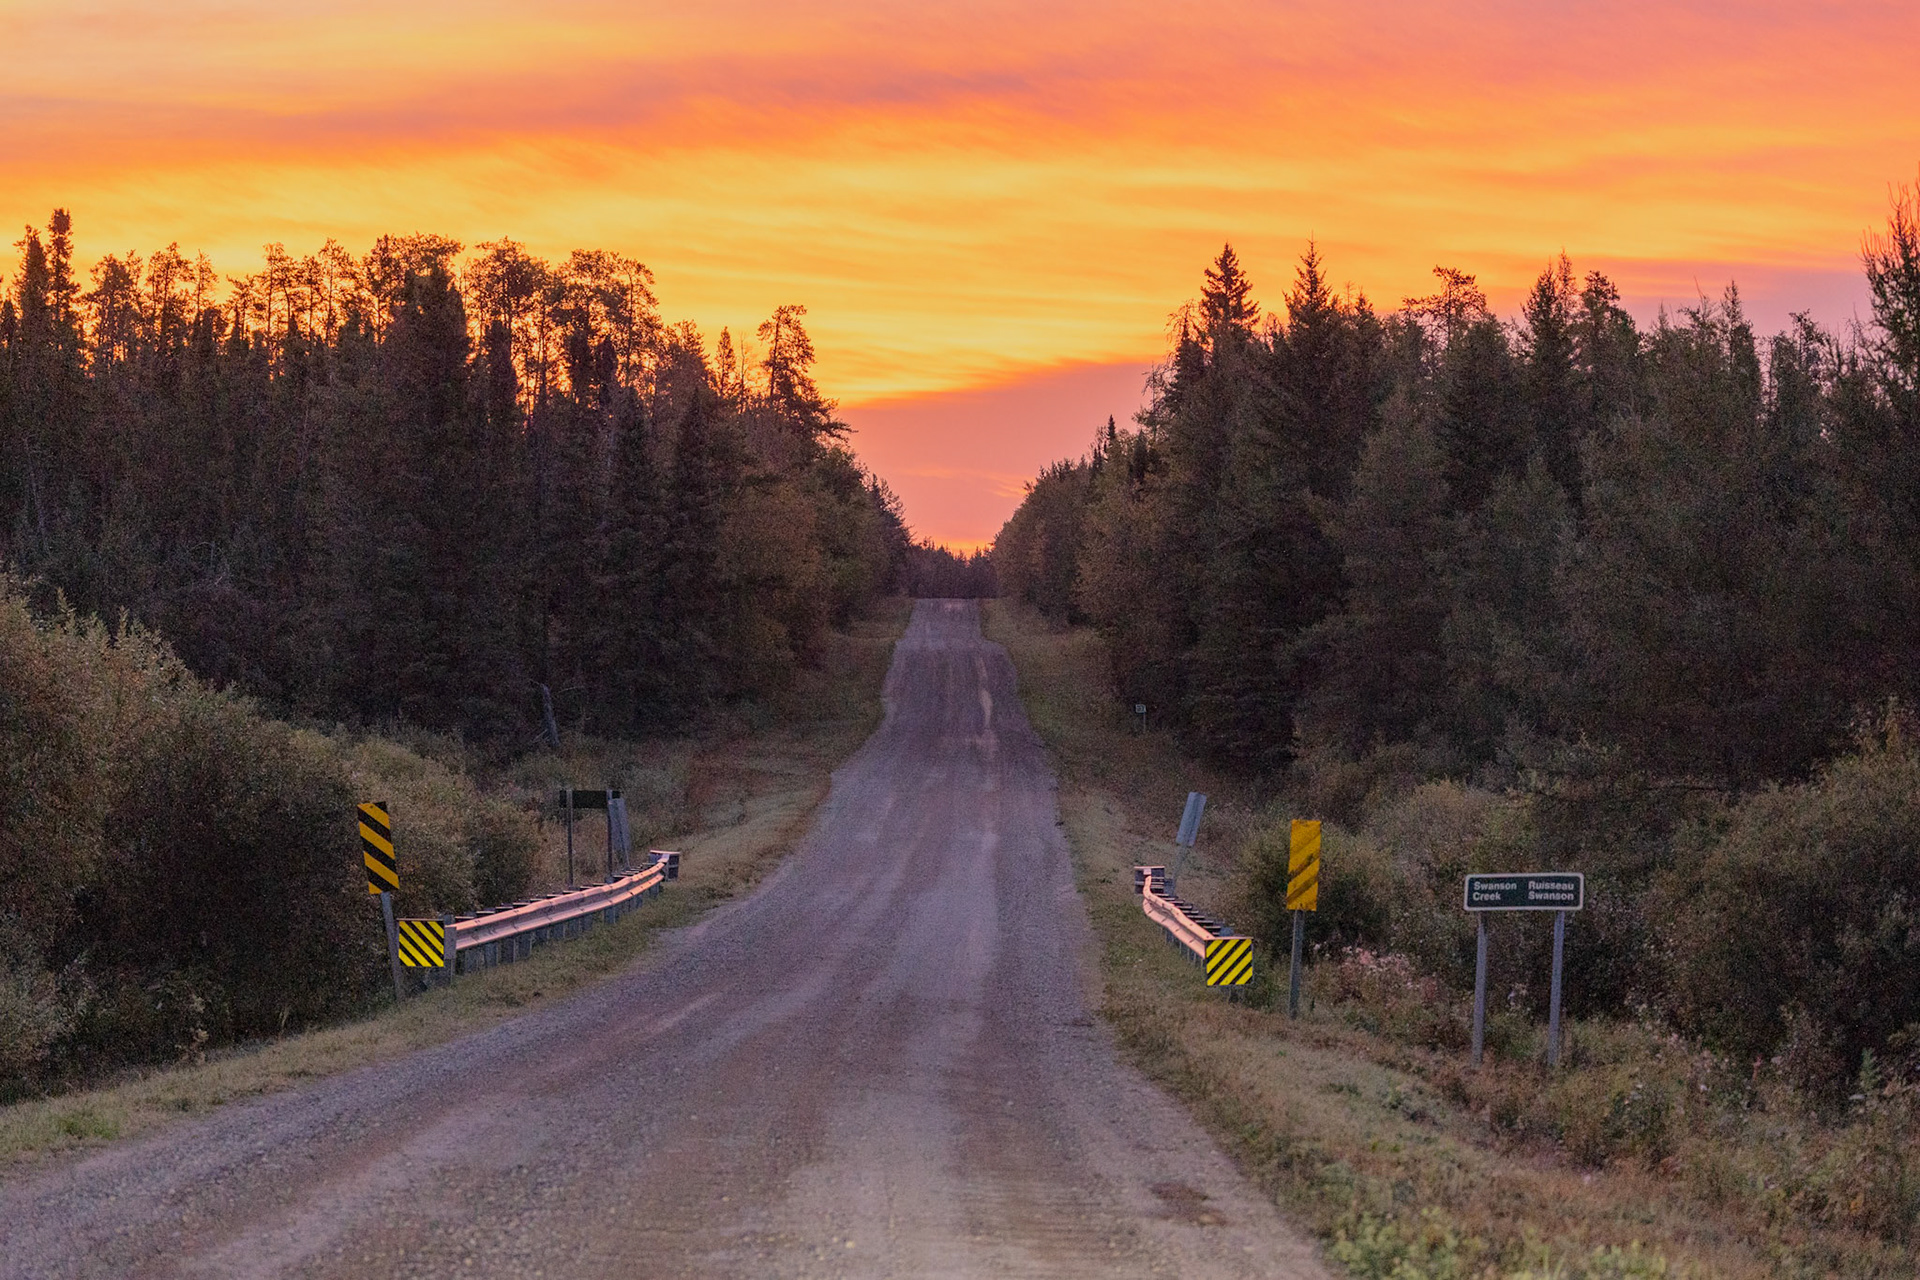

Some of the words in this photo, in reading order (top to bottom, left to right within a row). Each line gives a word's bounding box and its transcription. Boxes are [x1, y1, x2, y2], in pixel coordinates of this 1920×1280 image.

[1473, 881, 1517, 890] Swanson
[1528, 881, 1574, 890] Ruisseau
[1472, 892, 1501, 901] Creek
[1528, 891, 1574, 900] Swanson
